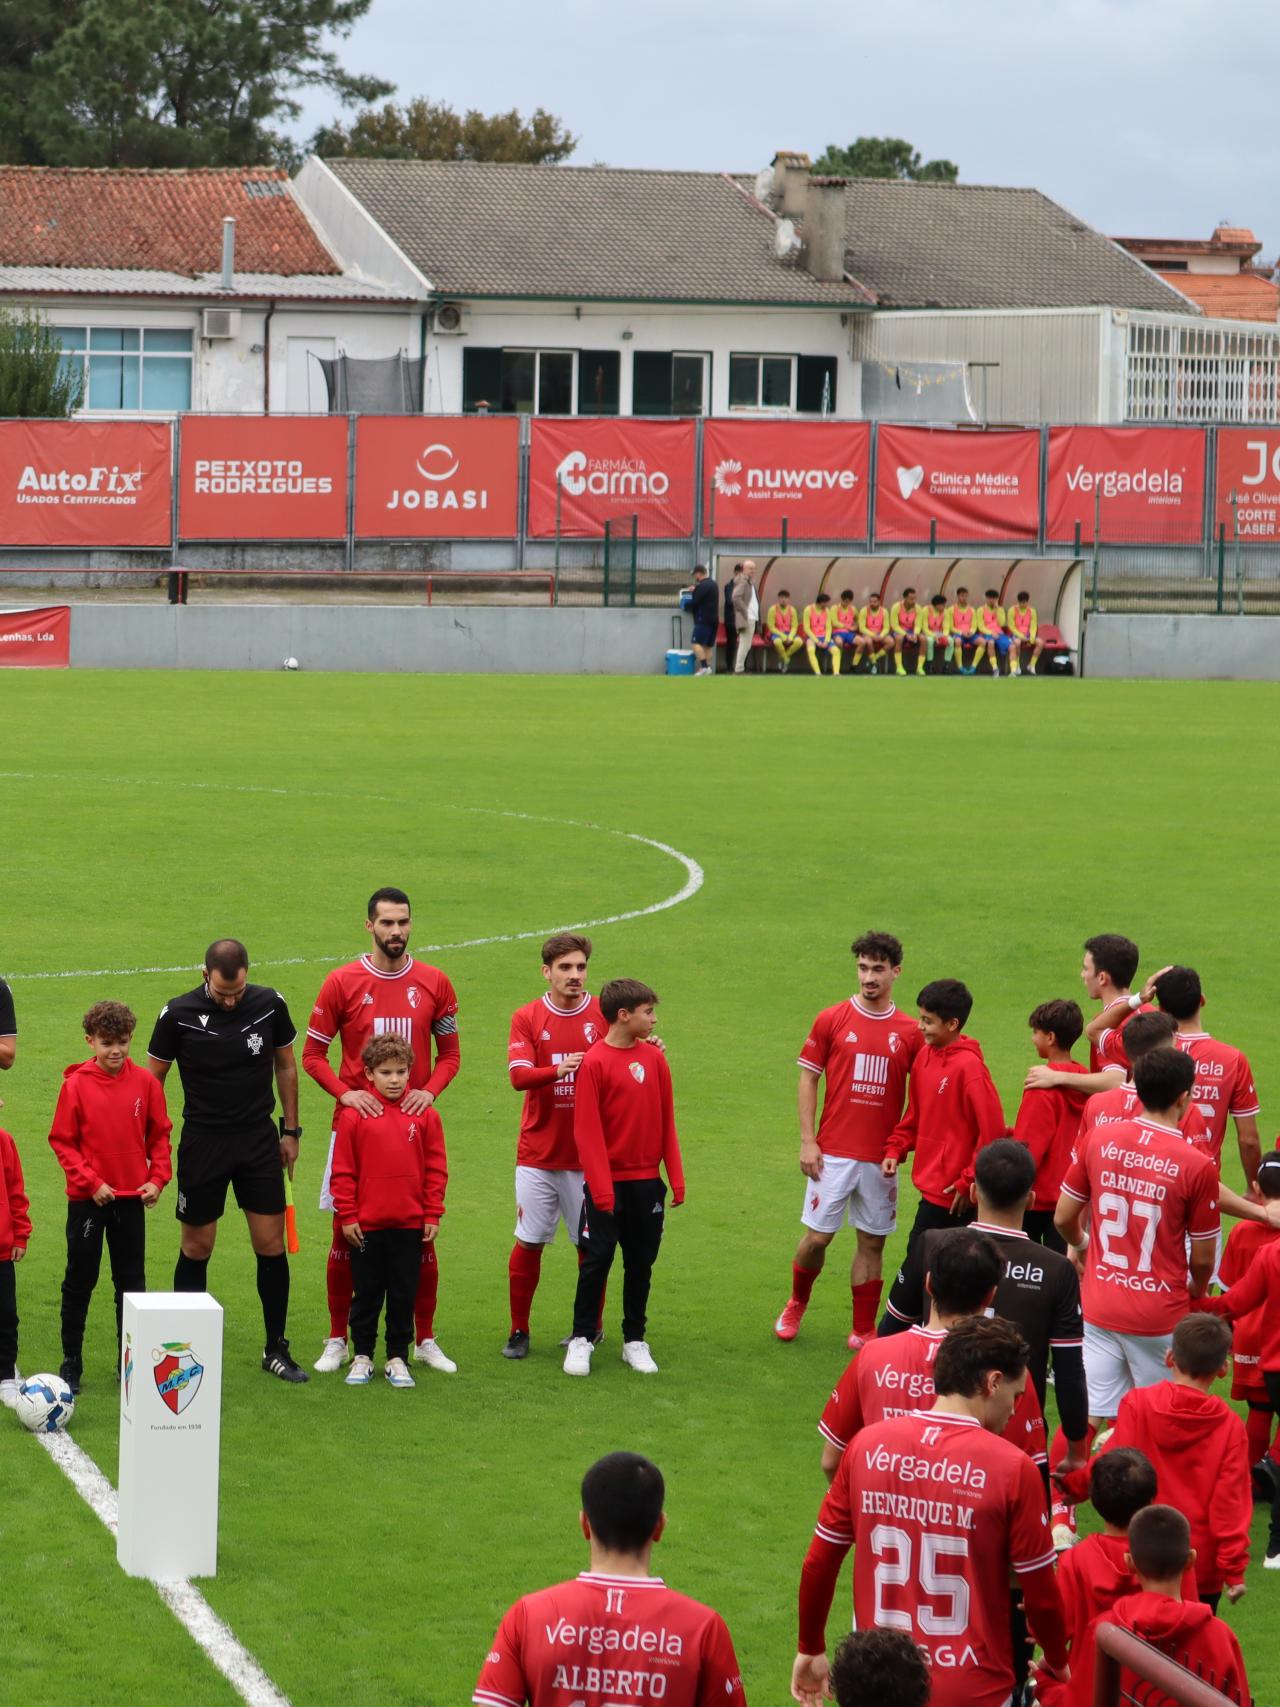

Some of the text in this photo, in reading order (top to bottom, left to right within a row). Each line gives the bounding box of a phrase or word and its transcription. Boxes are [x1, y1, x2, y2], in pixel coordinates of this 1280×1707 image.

[195, 460, 303, 477] PEIXOTO
[588, 457, 647, 472] FARMÁCIA
[17, 465, 140, 494] AutoFix
[195, 477, 332, 494] RODRIGUES
[747, 467, 855, 489] nuwave
[975, 472, 1019, 486] Médica
[1066, 463, 1183, 498] Vergadela
[387, 489, 487, 510] JOBASI
[747, 490, 803, 499] Assist Service
[929, 485, 1019, 496] Dentária de Merelim
[1237, 508, 1276, 521] CORTE
[1237, 523, 1276, 535] LASER
[37, 632, 54, 641] Lda
[554, 1086, 575, 1096] HEFE
[851, 1083, 886, 1096] HEFESTO
[1192, 1085, 1221, 1100] STA
[1101, 1141, 1180, 1177] Vergadela
[1100, 1171, 1167, 1202] CARNEIRO
[1098, 1192, 1161, 1273] 27
[875, 1364, 936, 1398] Verga
[865, 1443, 987, 1490] Vergadela
[861, 1490, 977, 1531] HENRIQUE M.
[870, 1524, 971, 1637] 25
[546, 1617, 682, 1656] Vergadela
[552, 1664, 667, 1699] ALBERTO
